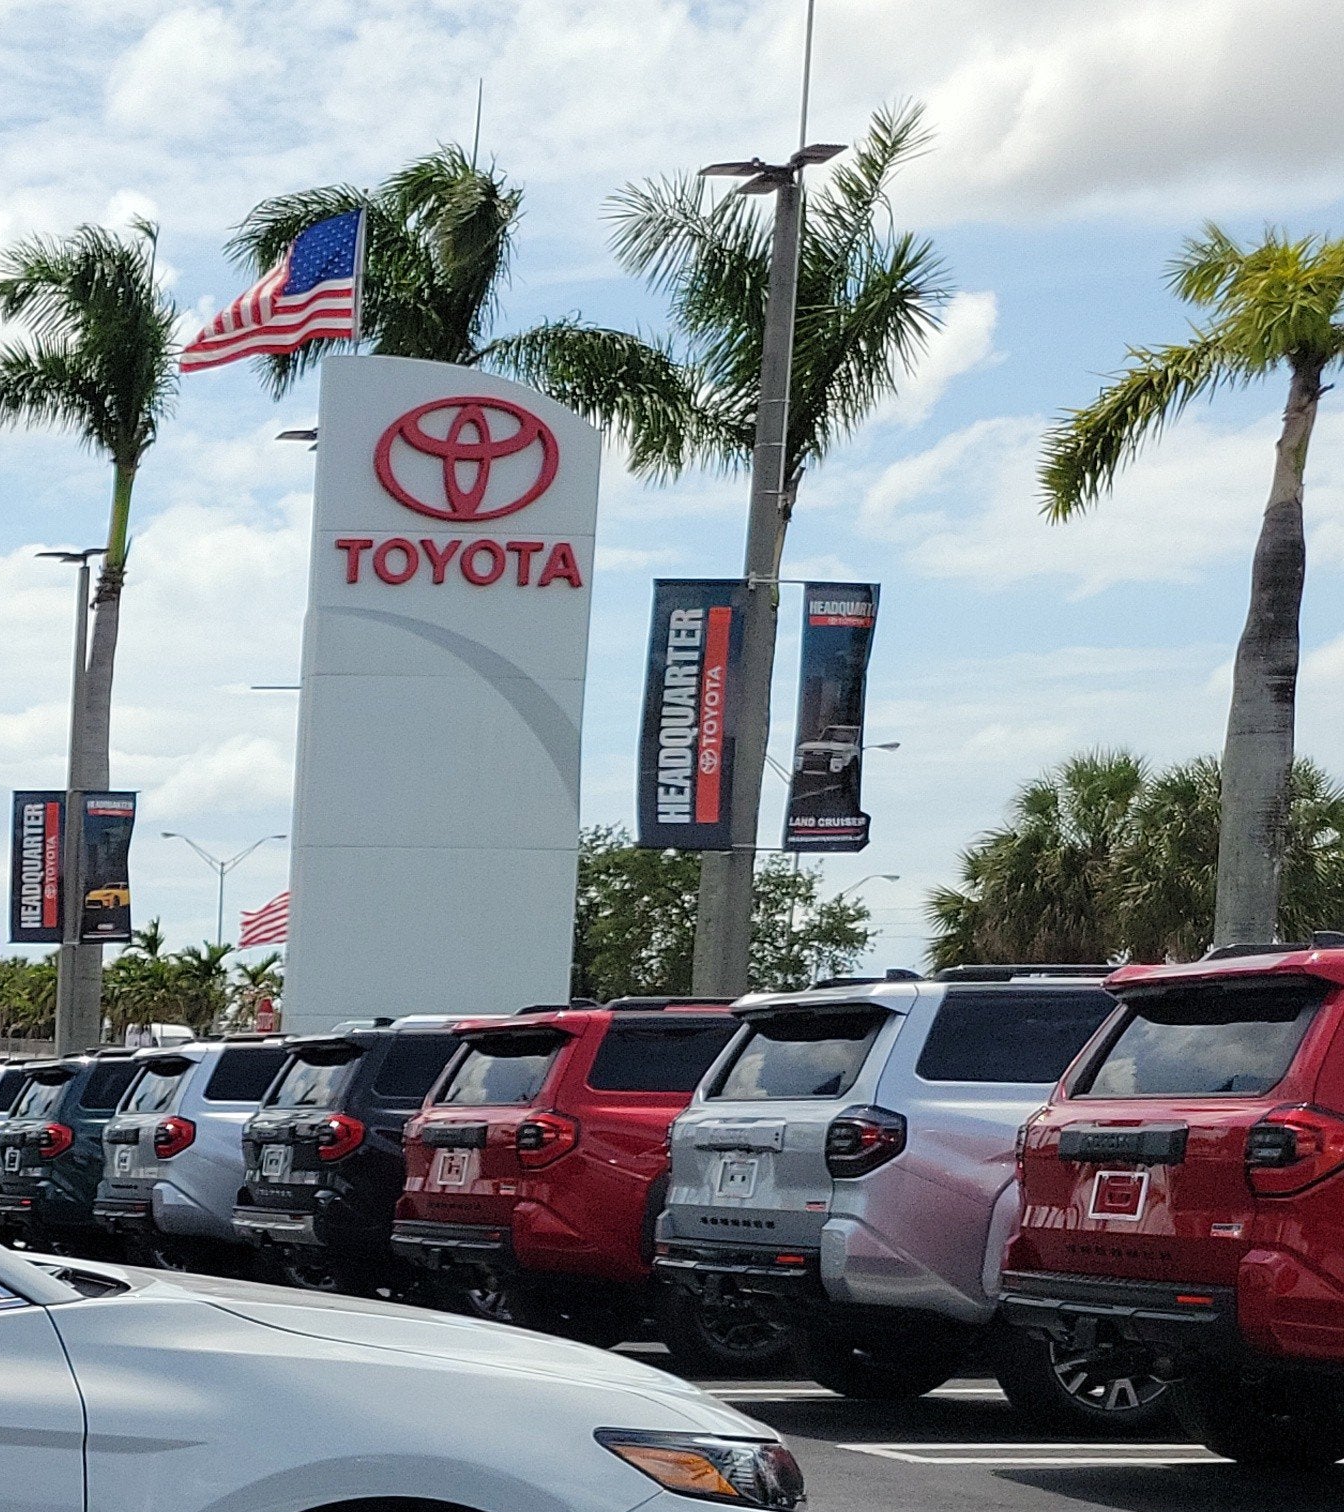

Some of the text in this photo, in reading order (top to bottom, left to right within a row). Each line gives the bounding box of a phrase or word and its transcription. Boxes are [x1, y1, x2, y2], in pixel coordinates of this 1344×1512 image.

[335, 538, 583, 588] TOYOTA
[657, 608, 705, 824] HEADQUARTER
[702, 665, 723, 747] TOYOTA
[788, 817, 866, 827] LAND CRUISER
[20, 802, 45, 929] HEADQUARTER
[45, 836, 57, 882] TOYOTA
